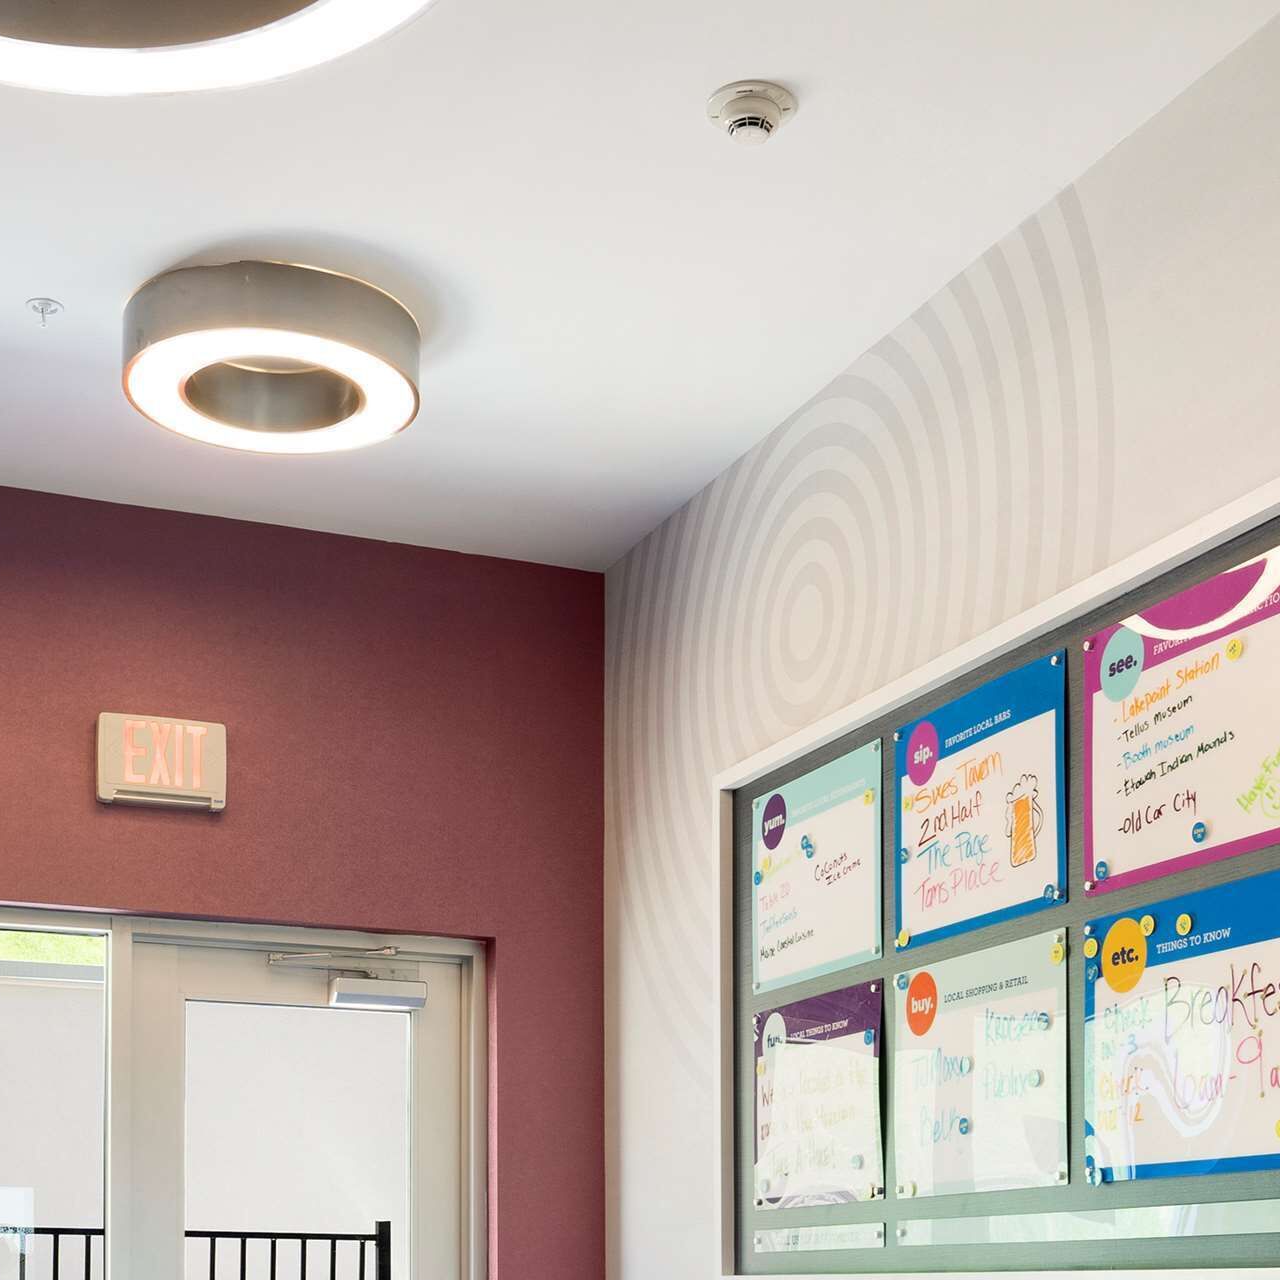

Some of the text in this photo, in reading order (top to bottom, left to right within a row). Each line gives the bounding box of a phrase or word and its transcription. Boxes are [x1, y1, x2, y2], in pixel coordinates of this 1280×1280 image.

[1108, 654, 1138, 677] see.
[1176, 652, 1221, 689] Station
[944, 709, 1011, 748] FAVORITE LOCAL BARS
[123, 719, 208, 790] EXIT
[914, 743, 933, 765] sip.
[918, 790, 982, 848] 2nd Half
[1145, 805, 1166, 825] Car
[1173, 789, 1197, 816] City
[764, 814, 785, 836] yum.
[916, 839, 953, 876] The
[1156, 928, 1232, 954] THINGS TO KNOW
[1111, 946, 1139, 967] etc.
[944, 991, 964, 1004] LOCAL
[965, 982, 998, 999] SHOPPING
[1004, 975, 1029, 989] RETAIL
[911, 996, 934, 1015] buy.
